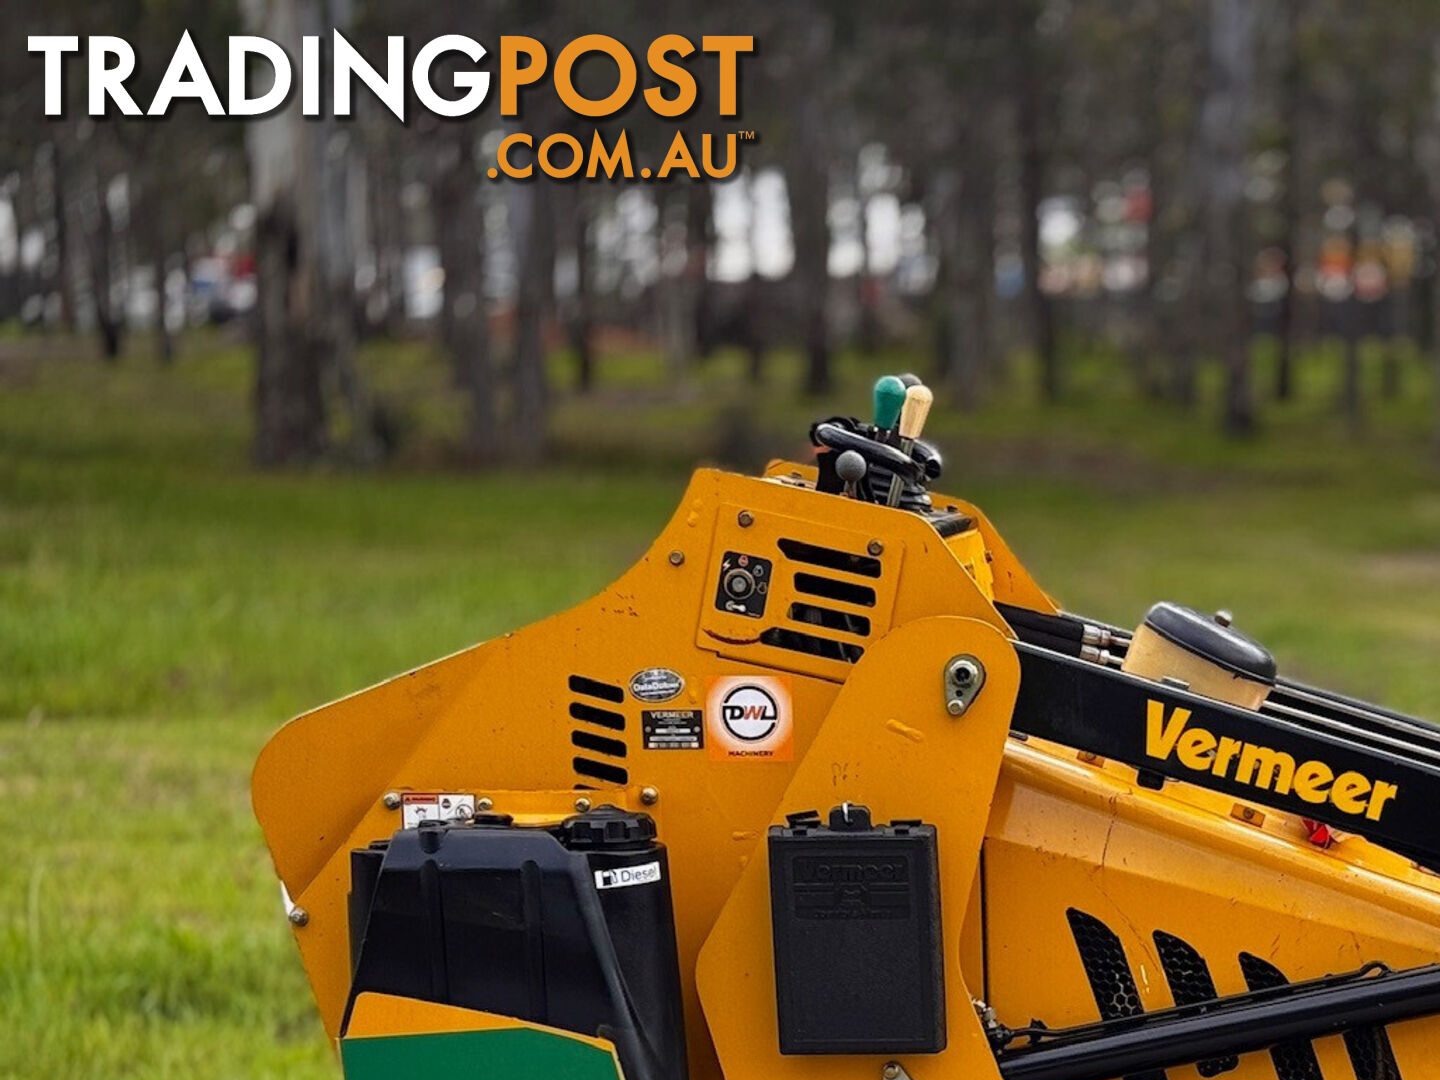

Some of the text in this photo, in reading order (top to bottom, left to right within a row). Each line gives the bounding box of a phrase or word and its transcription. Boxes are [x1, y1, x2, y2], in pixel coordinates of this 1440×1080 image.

[723, 706, 777, 720] DWL
[1146, 699, 1398, 821] Vermeer
[621, 866, 656, 882] Diesel
